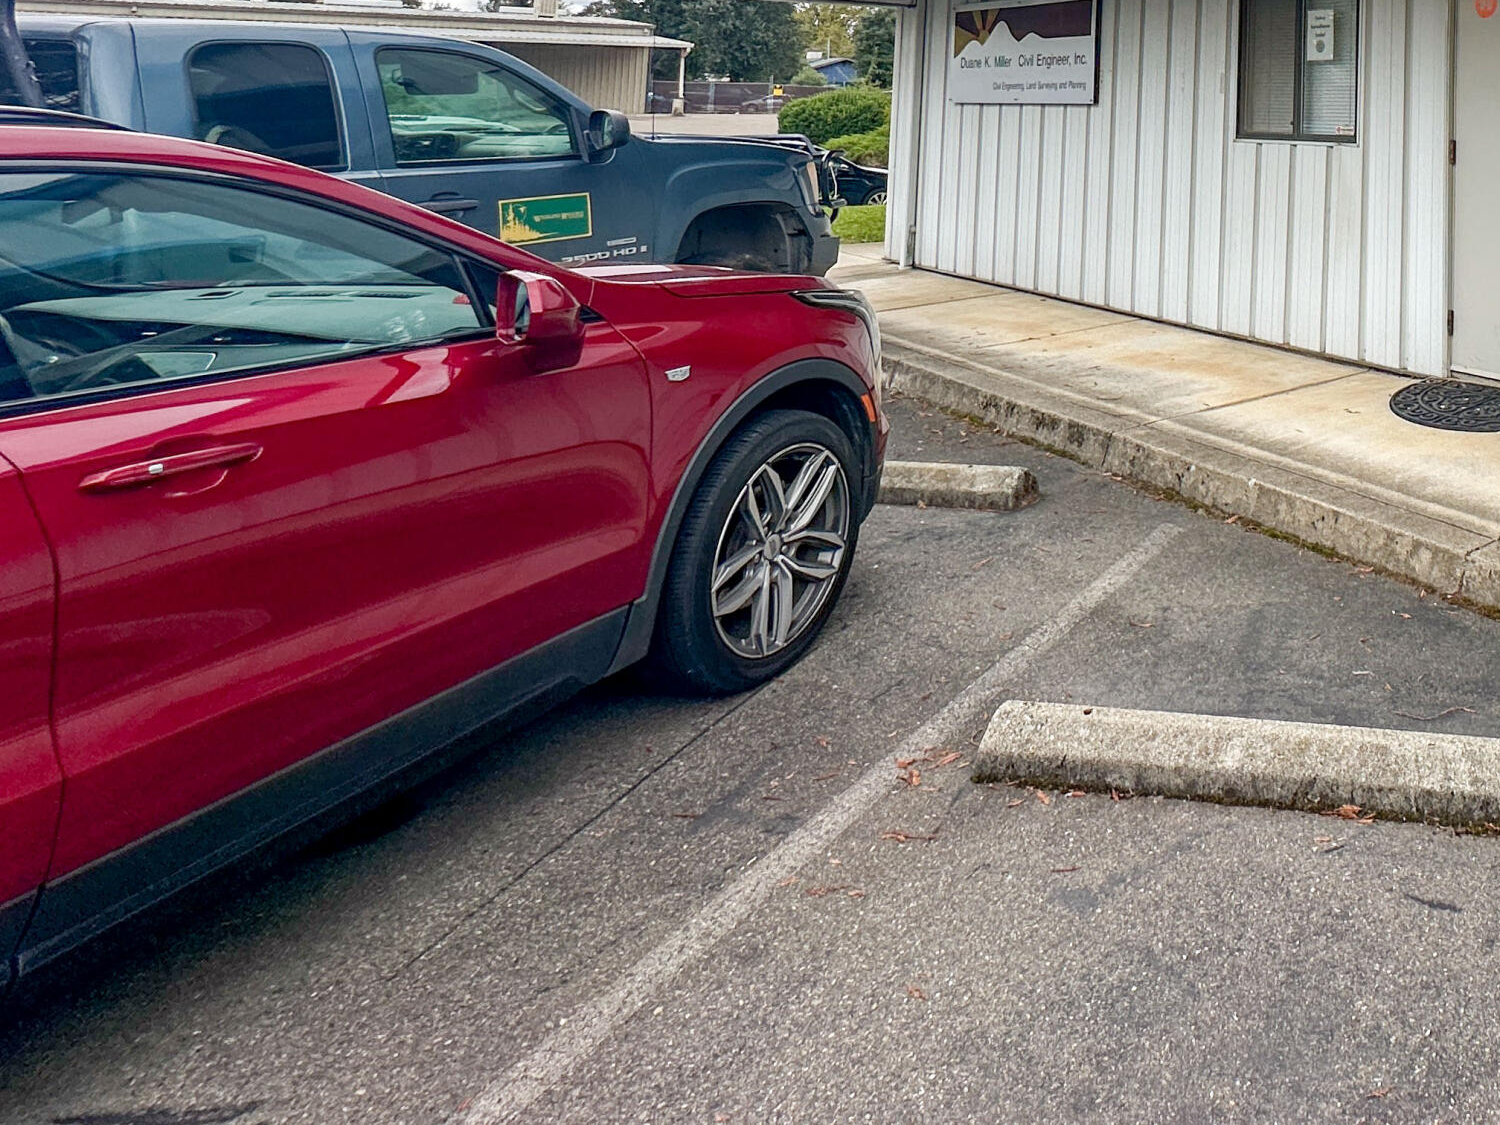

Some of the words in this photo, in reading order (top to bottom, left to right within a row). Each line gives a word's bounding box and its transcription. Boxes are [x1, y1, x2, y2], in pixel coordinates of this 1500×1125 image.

[960, 57, 982, 69] Duane
[984, 56, 991, 67] K.
[994, 55, 1012, 67] Miller
[1018, 54, 1034, 67] Civil
[1037, 53, 1072, 69] Engineer,
[1074, 52, 1087, 65] Inc.
[1058, 80, 1068, 90] and
[613, 246, 637, 257] HD
